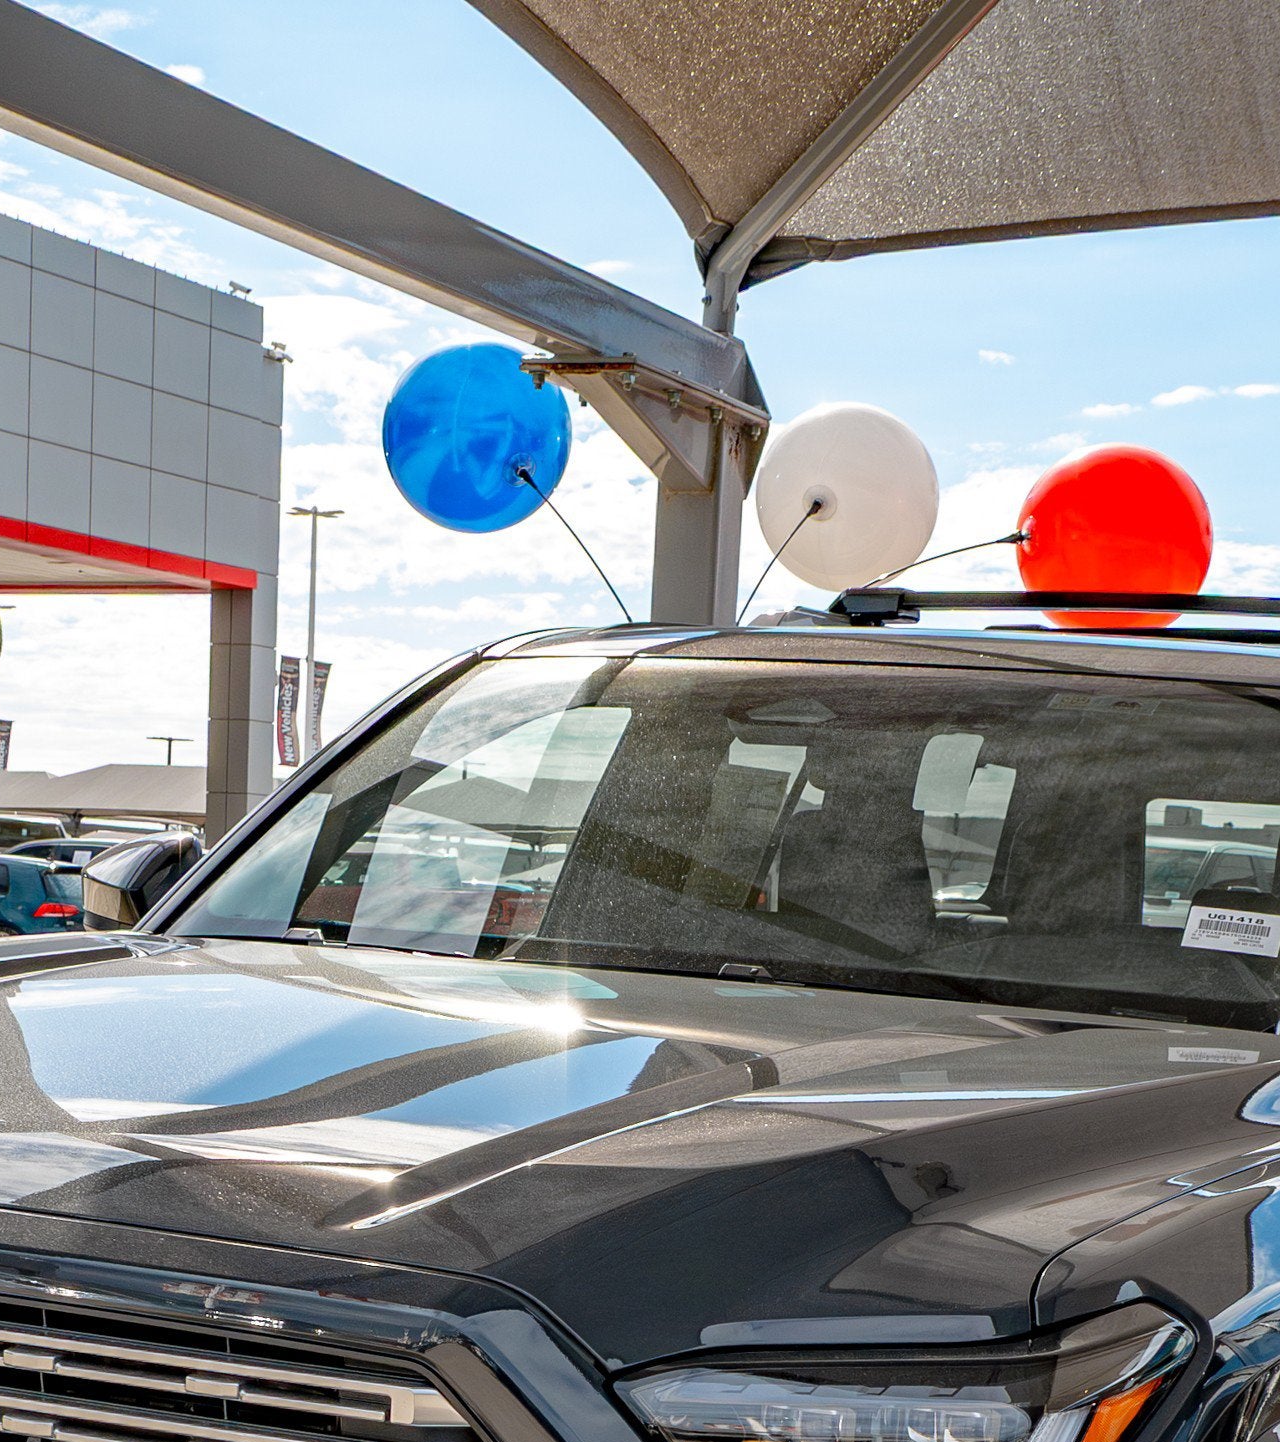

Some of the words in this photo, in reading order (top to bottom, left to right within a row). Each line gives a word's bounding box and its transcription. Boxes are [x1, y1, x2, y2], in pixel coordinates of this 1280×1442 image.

[281, 683, 294, 734] Vehicles
[283, 735, 295, 763] New
[1208, 913, 1265, 924] U61418
